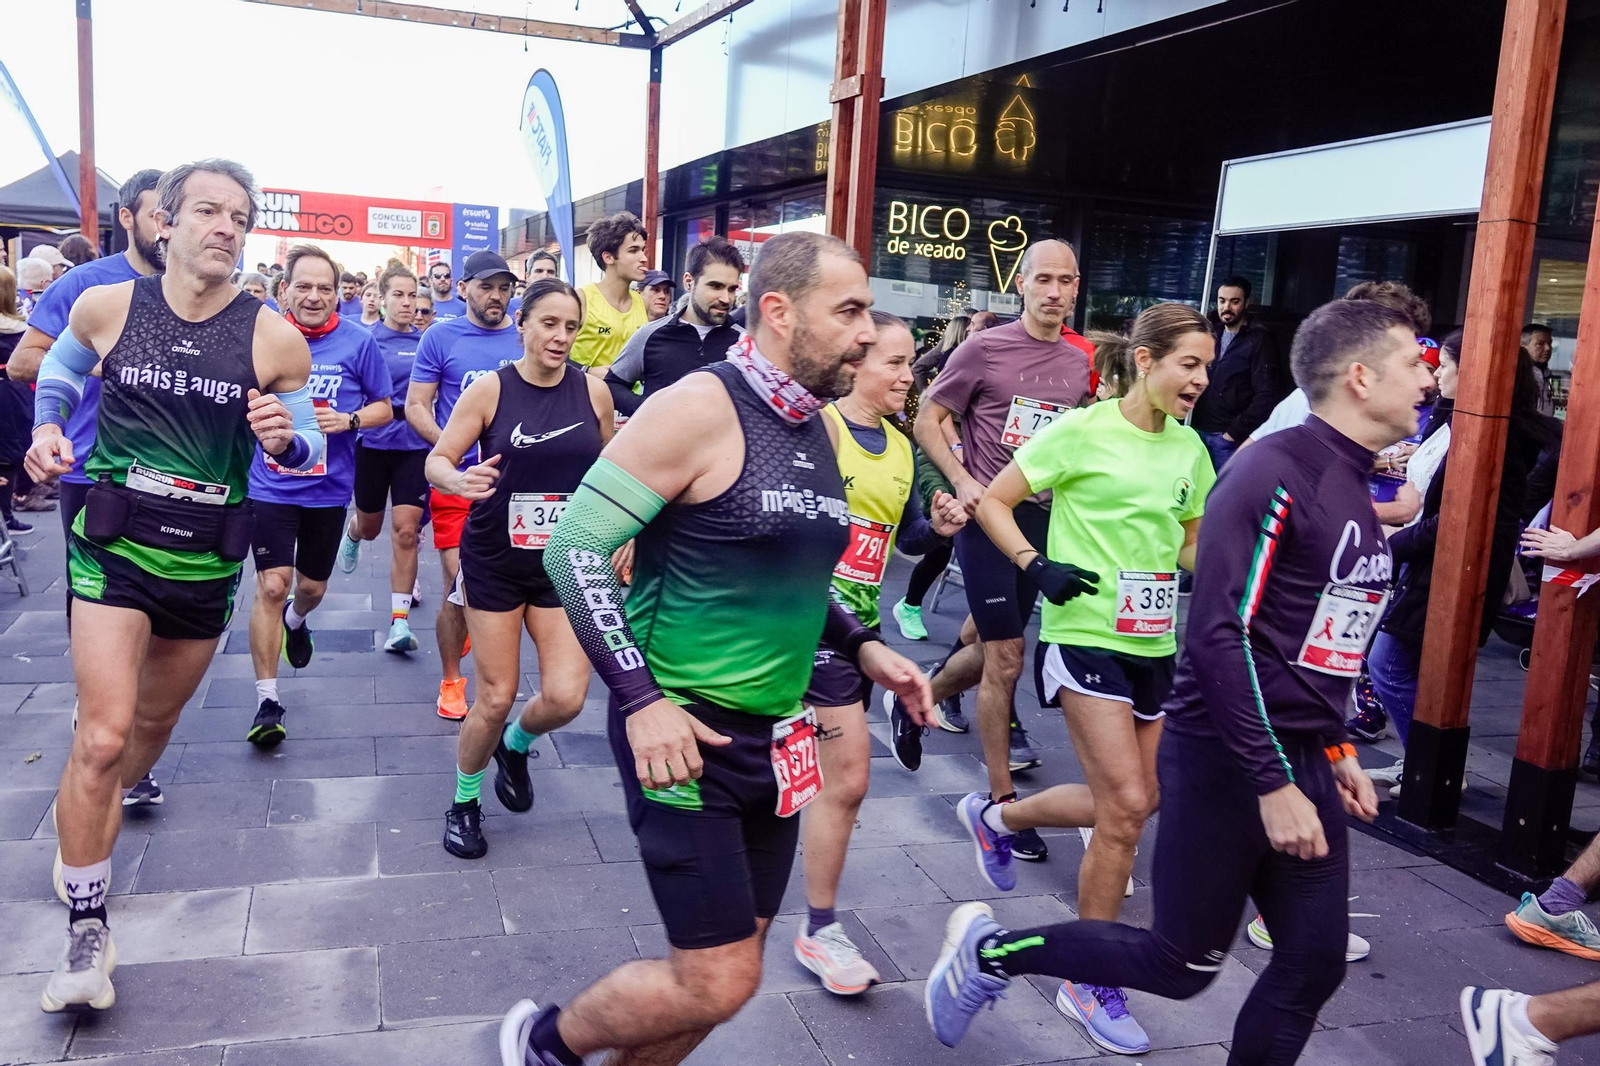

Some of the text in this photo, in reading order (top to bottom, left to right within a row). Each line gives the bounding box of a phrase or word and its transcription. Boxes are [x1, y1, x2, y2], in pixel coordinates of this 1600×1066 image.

[372, 212, 418, 223] CONCELLO
[377, 221, 412, 231] DE VIGO
[888, 200, 970, 241] BICO
[887, 236, 966, 260] de xeado
[598, 326, 611, 334] DK
[171, 345, 201, 356] amura
[120, 363, 242, 404] máis que auga
[307, 374, 343, 398] RER
[160, 525, 194, 538] KIPRUN
[567, 548, 646, 671] SPORTS
[1140, 587, 1174, 610] 385
[788, 735, 816, 778] 572
